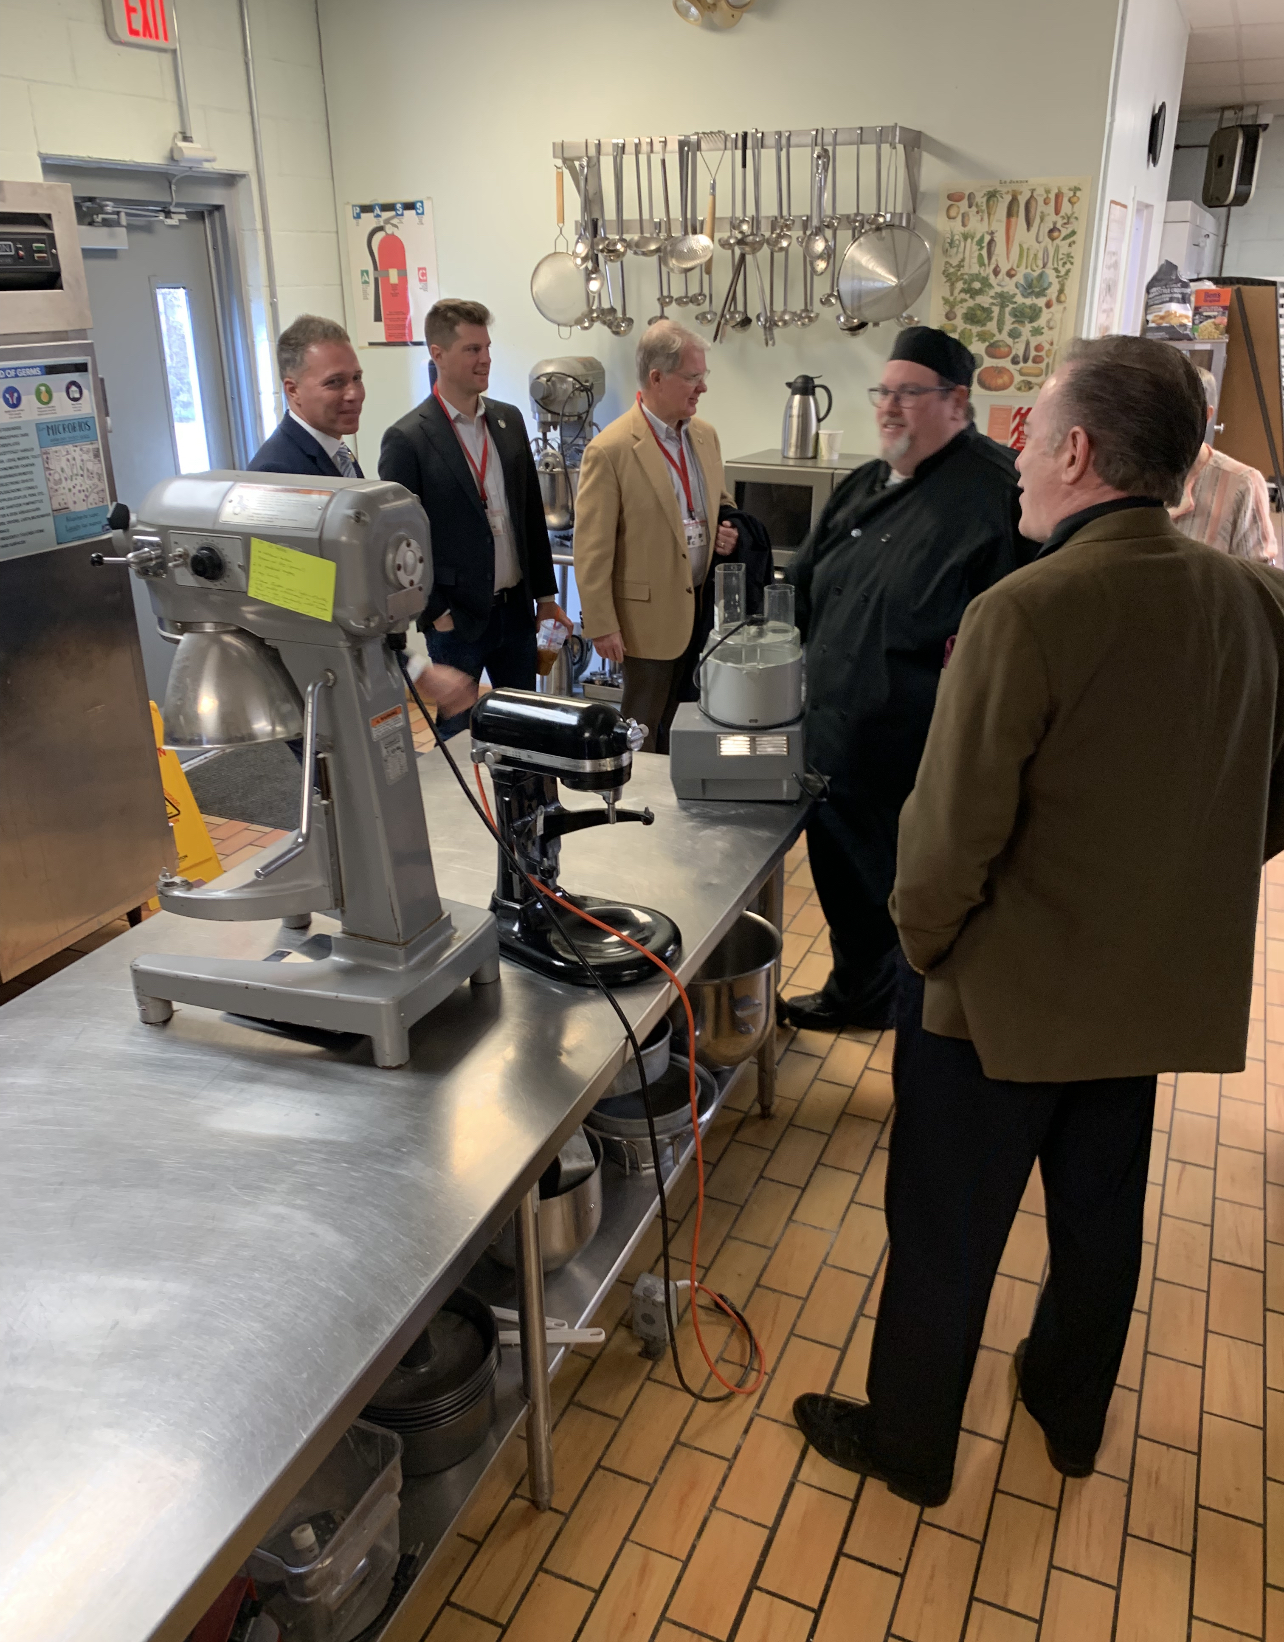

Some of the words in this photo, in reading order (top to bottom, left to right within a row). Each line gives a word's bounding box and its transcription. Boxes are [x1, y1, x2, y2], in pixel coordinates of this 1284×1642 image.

[123, 0, 168, 43] EXIT
[5, 369, 16, 378] OF
[16, 367, 42, 377] GERMS
